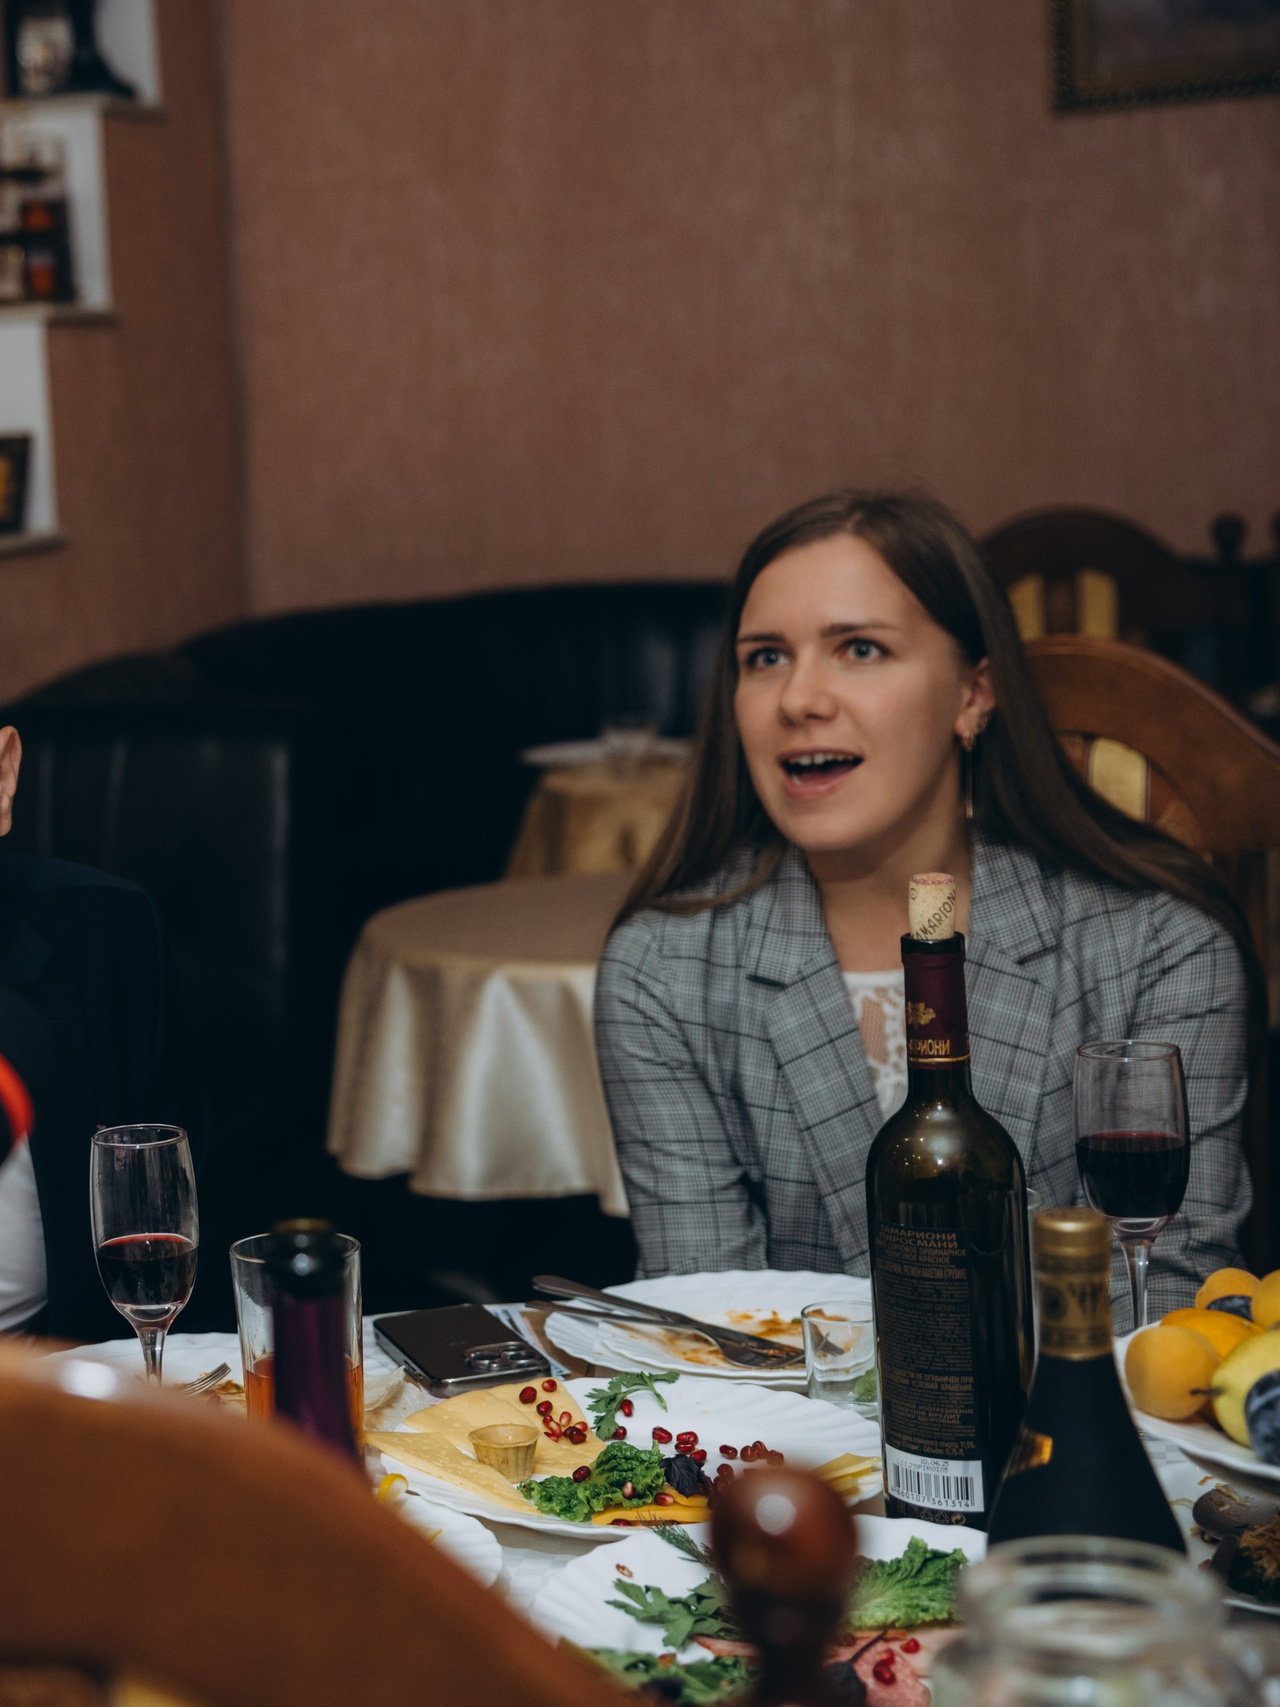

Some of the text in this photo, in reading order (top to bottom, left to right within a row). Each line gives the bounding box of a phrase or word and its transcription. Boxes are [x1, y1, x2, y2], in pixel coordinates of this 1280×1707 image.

[880, 1225, 957, 1241] ТАМАРИОНИ
[879, 1232, 958, 1248] ПИРОСМАНИ
[919, 1248, 967, 1257] ОРДИНАРНОЕ
[919, 1255, 951, 1264] КРАСНОЕ
[924, 1374, 960, 1383] ОГРАНИЧЕН
[920, 1458, 949, 1467] 10.04.25
[931, 1498, 970, 1508] 361314
